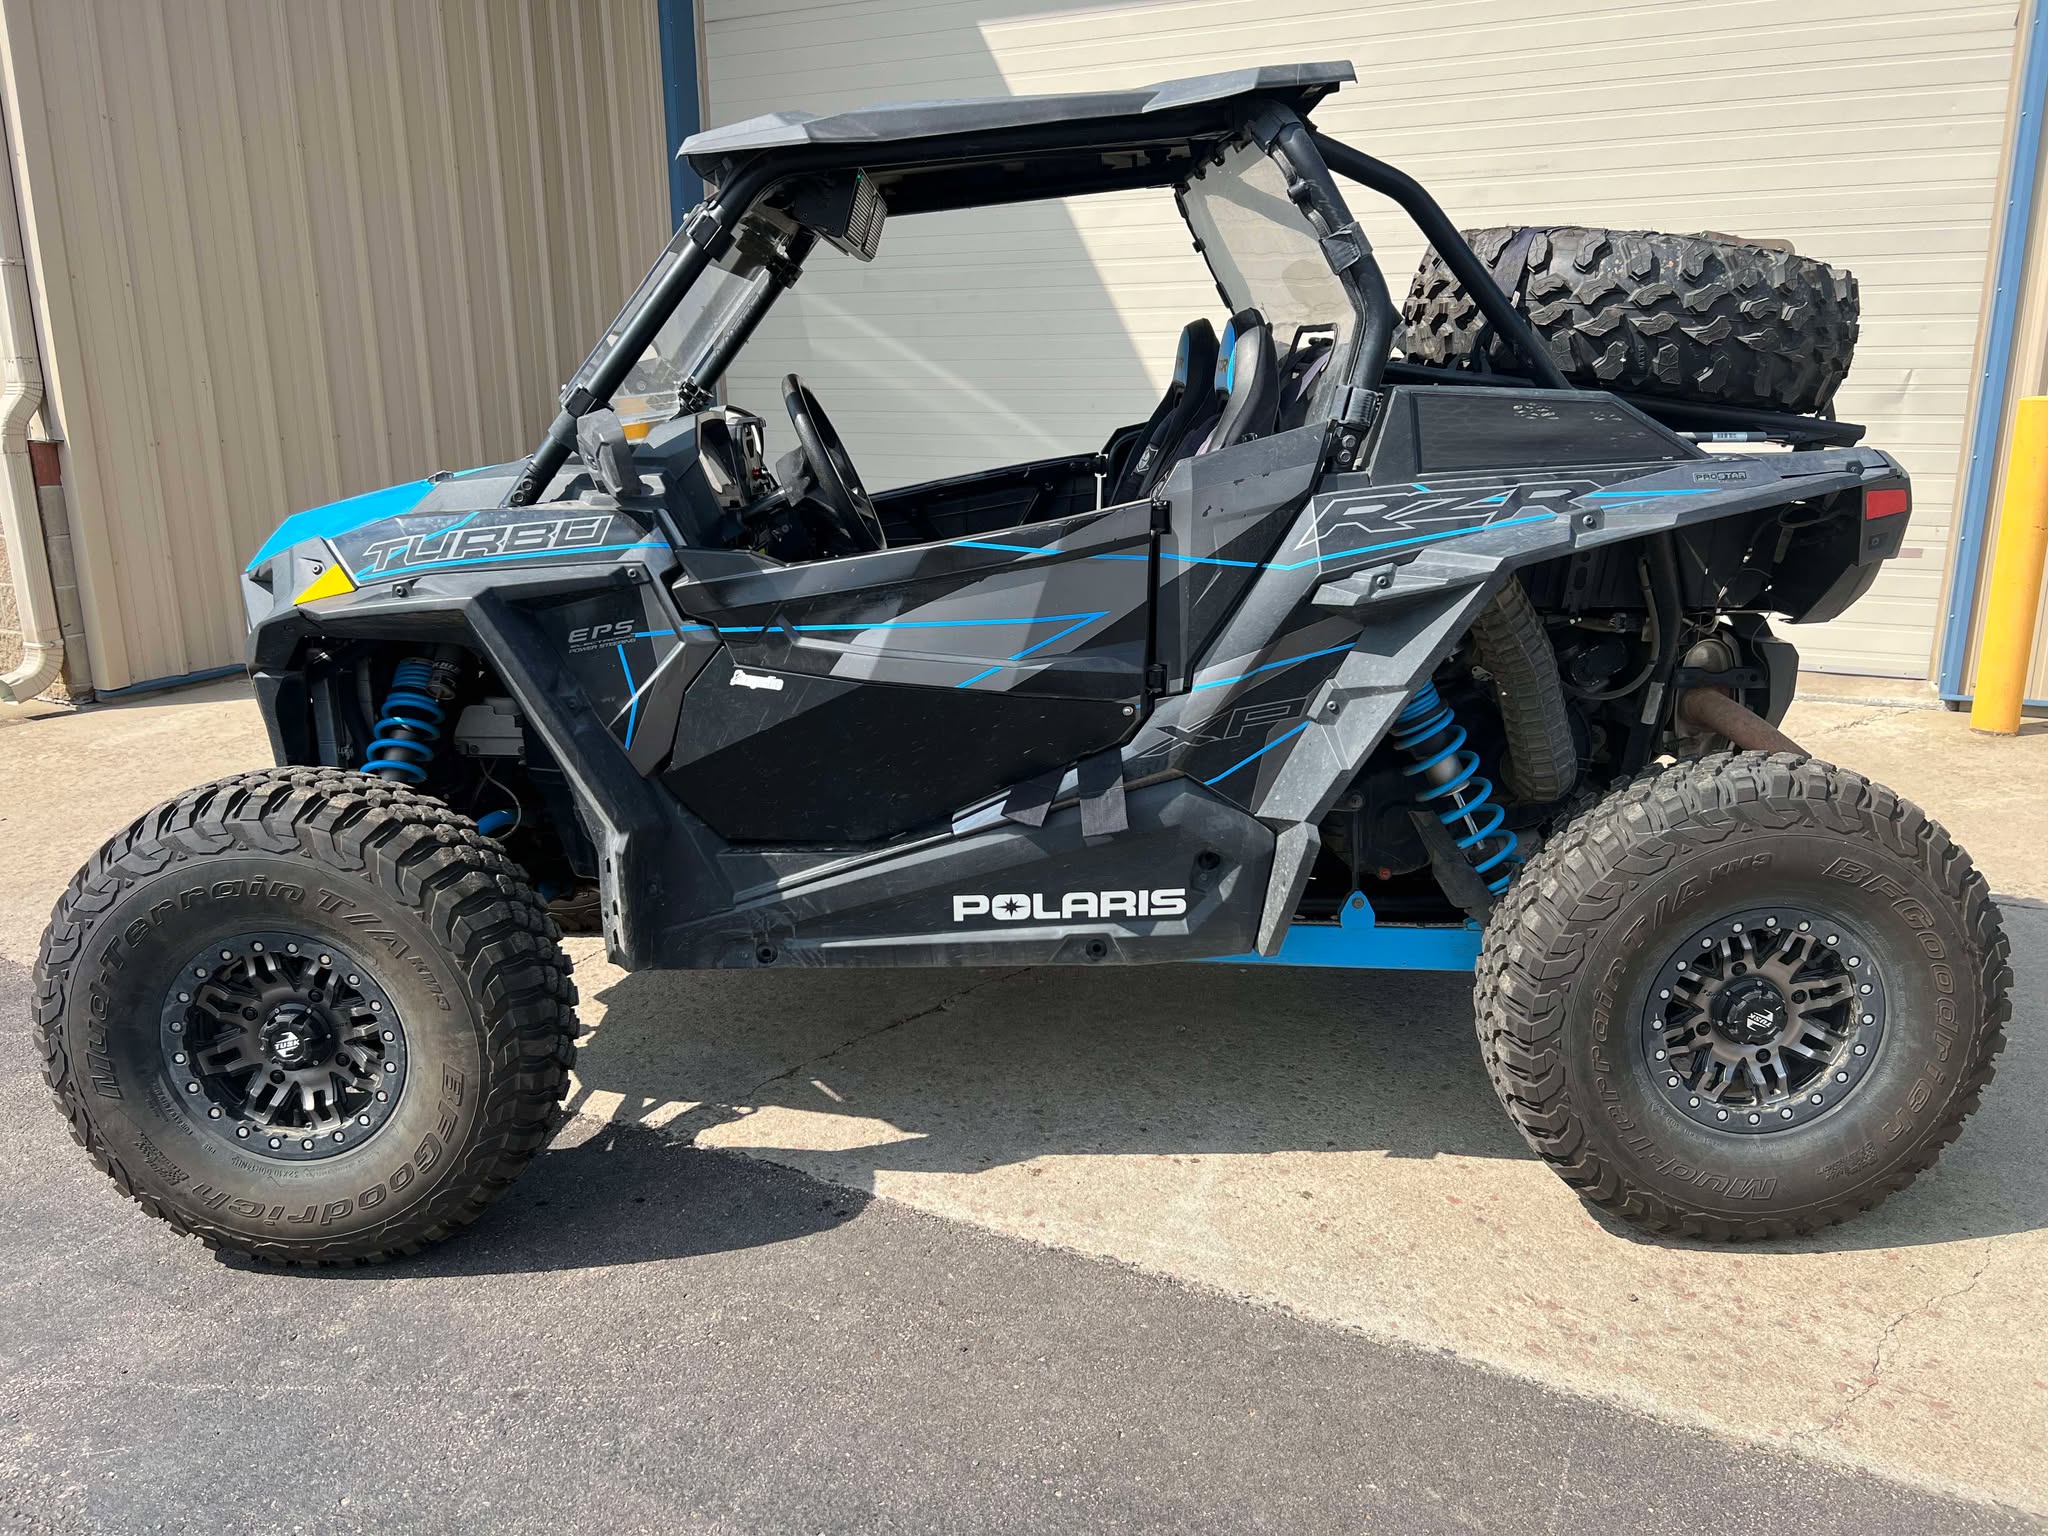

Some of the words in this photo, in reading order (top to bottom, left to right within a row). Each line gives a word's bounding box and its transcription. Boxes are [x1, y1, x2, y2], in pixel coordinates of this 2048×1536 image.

[1692, 470, 1747, 482] PROSTAR
[362, 515, 614, 573] TURBO
[1294, 480, 1605, 550] RZR
[568, 619, 635, 643] EPS
[568, 645, 598, 654] POWER
[953, 888, 1187, 922] POLARIS
[1621, 874, 1706, 949] T/A
[84, 874, 308, 1100] Mud-Terrain
[316, 887, 410, 960] T/A
[1820, 855, 1961, 1145] BFGoodrich
[273, 1038, 300, 1051] TUSK
[1747, 1011, 1773, 1029] TUSK
[1592, 957, 1778, 1200] Mud-Terrain
[191, 1061, 466, 1229] BFGoodrich
